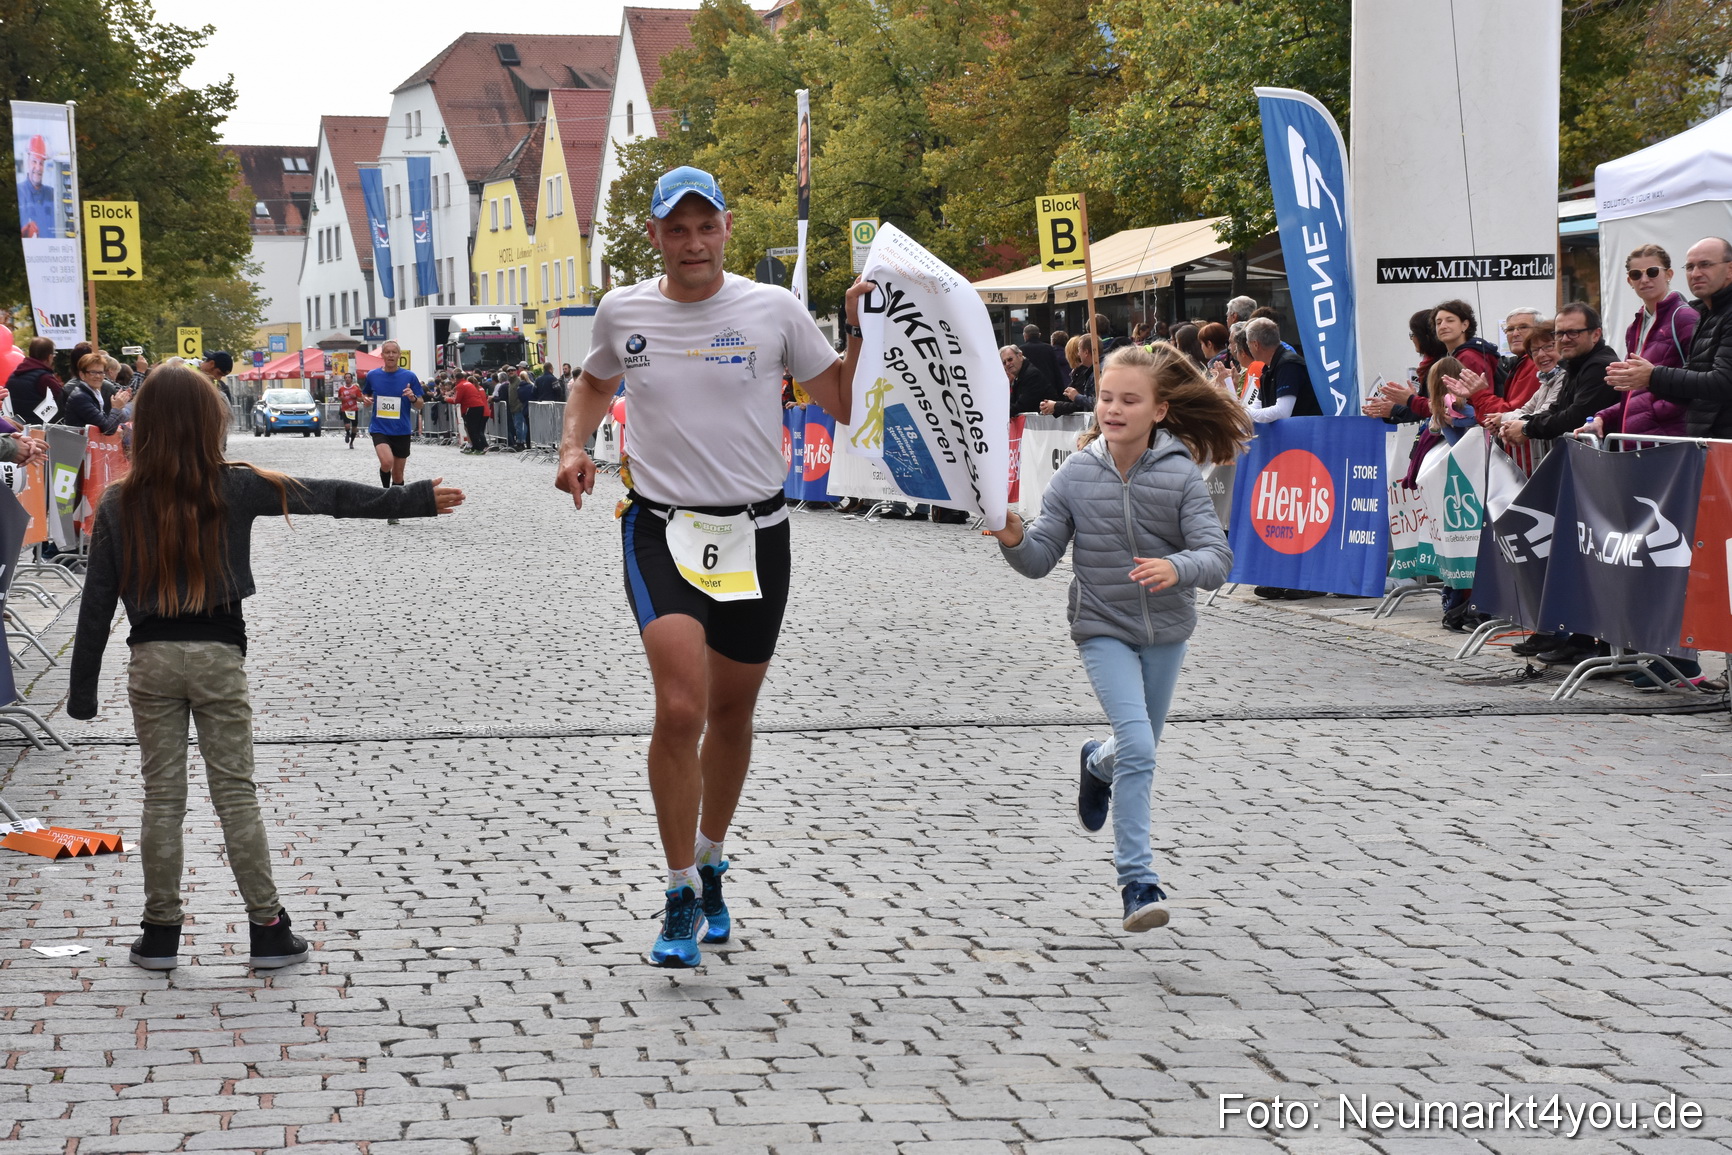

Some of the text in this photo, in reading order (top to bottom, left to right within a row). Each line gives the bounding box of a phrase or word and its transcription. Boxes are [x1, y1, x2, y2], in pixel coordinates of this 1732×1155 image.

[1042, 197, 1080, 213] Block
[1603, 190, 1665, 209] SOLUTIONS YOUR WAY.
[90, 204, 133, 219] Block
[859, 227, 870, 238] H
[1050, 217, 1077, 254] B
[99, 225, 128, 263] B
[498, 248, 513, 263] HOTEL
[898, 234, 959, 288] BERSCHNEIDER
[892, 238, 951, 294] BERSCHNEIDER
[1381, 257, 1553, 281] www.MINI-Partl.de
[180, 328, 199, 336] Block
[183, 337, 196, 354] C
[624, 355, 651, 364] PARTL
[939, 320, 988, 454] ein großes
[381, 403, 395, 411] 304
[884, 346, 956, 463] Sponsoren
[886, 426, 909, 457] Stadtlauf
[903, 424, 918, 443] 18.
[803, 438, 831, 470] ervis
[894, 425, 919, 466] Neumarkter
[1353, 465, 1378, 480] STORE
[1256, 471, 1330, 534] Hervis
[1351, 498, 1378, 512] ONLINE
[702, 522, 732, 532] BOCK
[1265, 525, 1294, 539] SPORTS
[1348, 530, 1375, 545] MOBILE
[702, 543, 719, 570] 6
[700, 577, 722, 588] Peter
